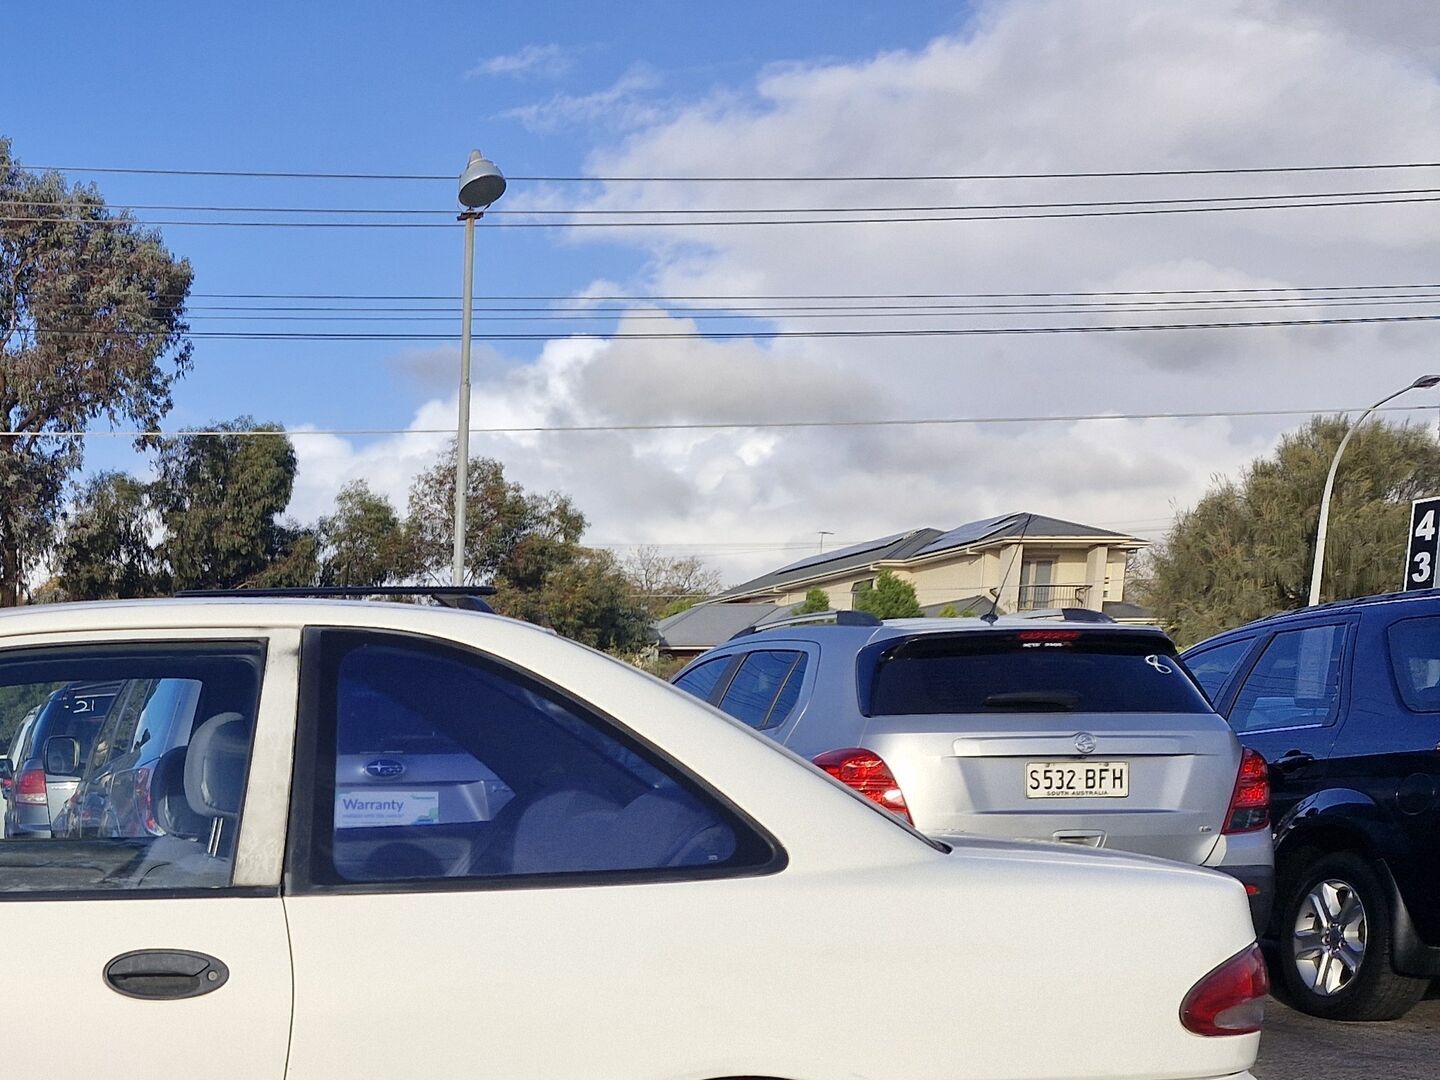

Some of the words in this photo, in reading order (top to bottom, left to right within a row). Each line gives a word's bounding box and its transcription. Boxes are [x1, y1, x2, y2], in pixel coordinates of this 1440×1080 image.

[1415, 509, 1436, 541] 4
[1411, 551, 1431, 583] 3
[73, 699, 95, 714] 21
[342, 798, 405, 813] Warranty
